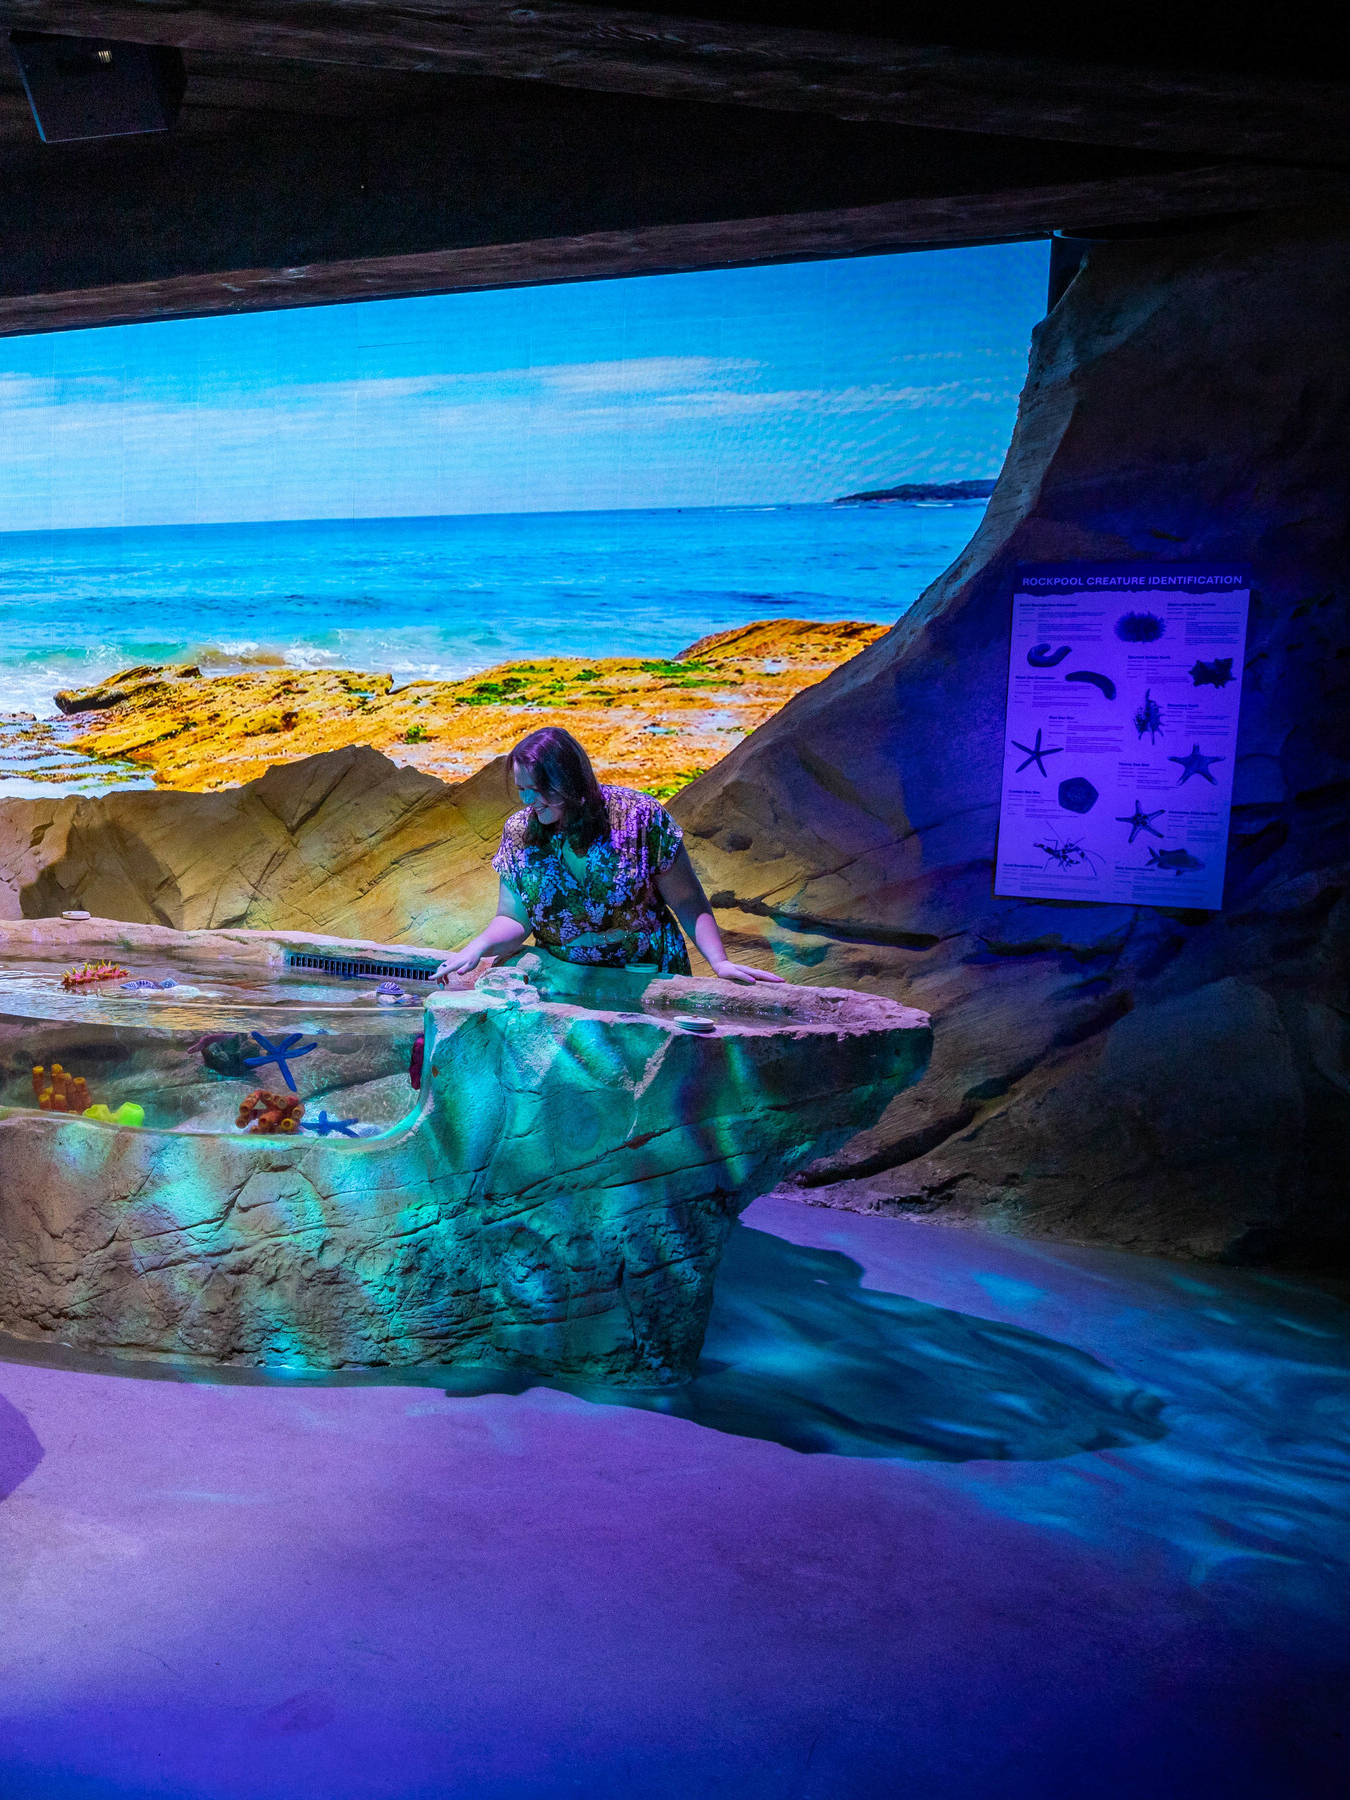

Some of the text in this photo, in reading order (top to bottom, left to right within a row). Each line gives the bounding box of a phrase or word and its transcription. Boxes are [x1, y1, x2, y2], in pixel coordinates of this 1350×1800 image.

[1022, 575, 1243, 586] ROCKPOOL CREATURE IDENTIFICATION
